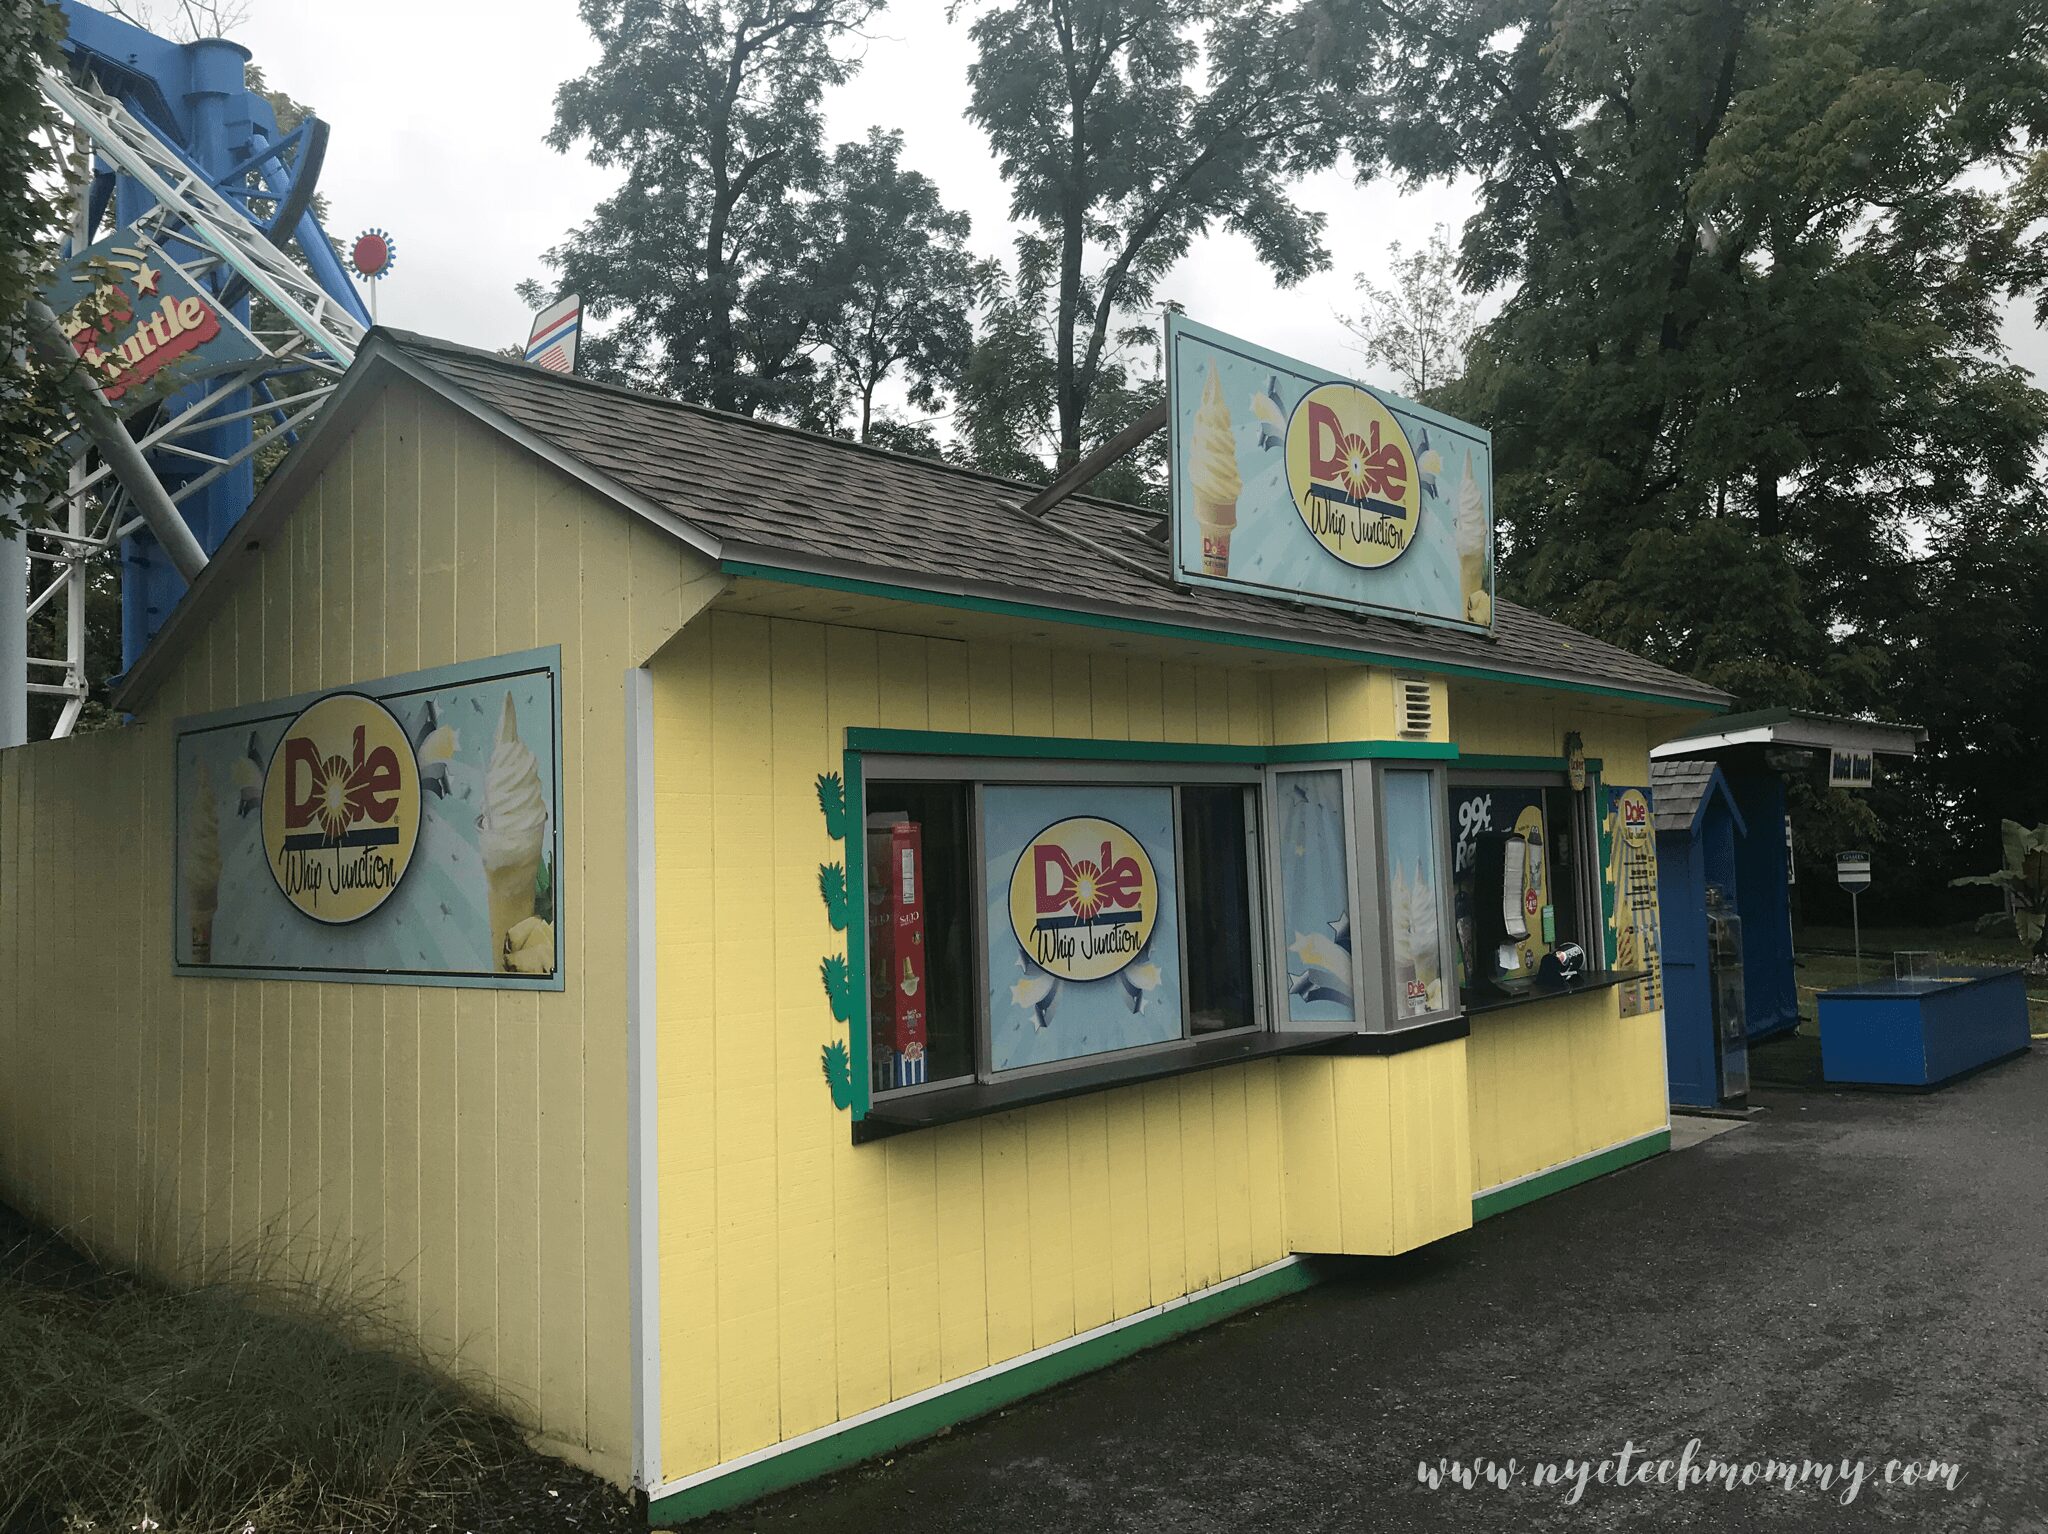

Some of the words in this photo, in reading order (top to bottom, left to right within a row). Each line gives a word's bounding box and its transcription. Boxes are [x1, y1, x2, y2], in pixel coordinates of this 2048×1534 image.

[80, 294, 205, 380] huttle
[1308, 400, 1407, 501] Dole
[1204, 537, 1227, 556] Dole
[1304, 488, 1346, 550] Whip
[1350, 502, 1406, 550] Junction
[285, 725, 401, 837] Dole
[1624, 800, 1645, 822] Dole
[1458, 793, 1492, 841] 99¢
[278, 842, 322, 908] Whip
[328, 836, 397, 894] Junction
[1034, 841, 1143, 920] Dole
[1029, 923, 1075, 971] Whip
[1081, 918, 1142, 960] Junction
[1407, 979, 1425, 996] Dole
